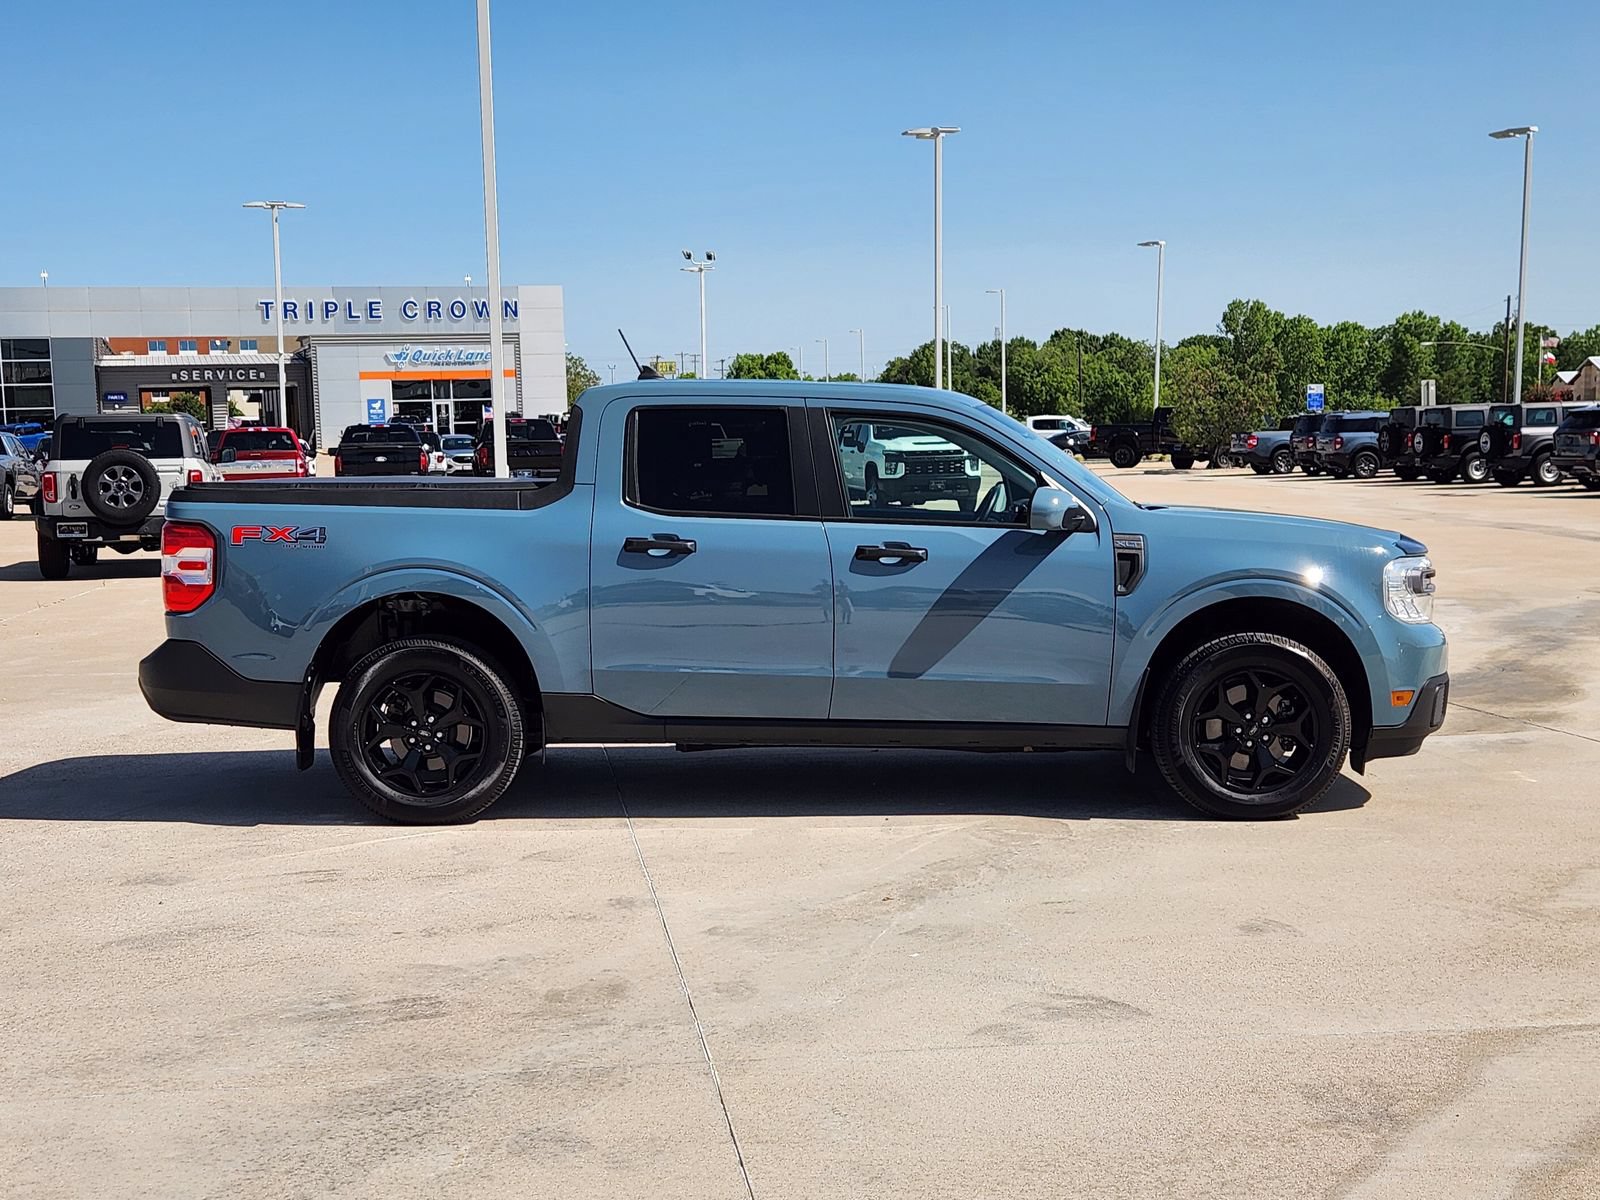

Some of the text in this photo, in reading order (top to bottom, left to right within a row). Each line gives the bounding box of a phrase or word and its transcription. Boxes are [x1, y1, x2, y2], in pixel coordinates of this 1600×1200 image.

[258, 299, 519, 321] TRIPLE CROWN
[410, 347, 492, 364] Quick Lane
[180, 369, 258, 381] SERVICE
[230, 525, 327, 546] FX4
